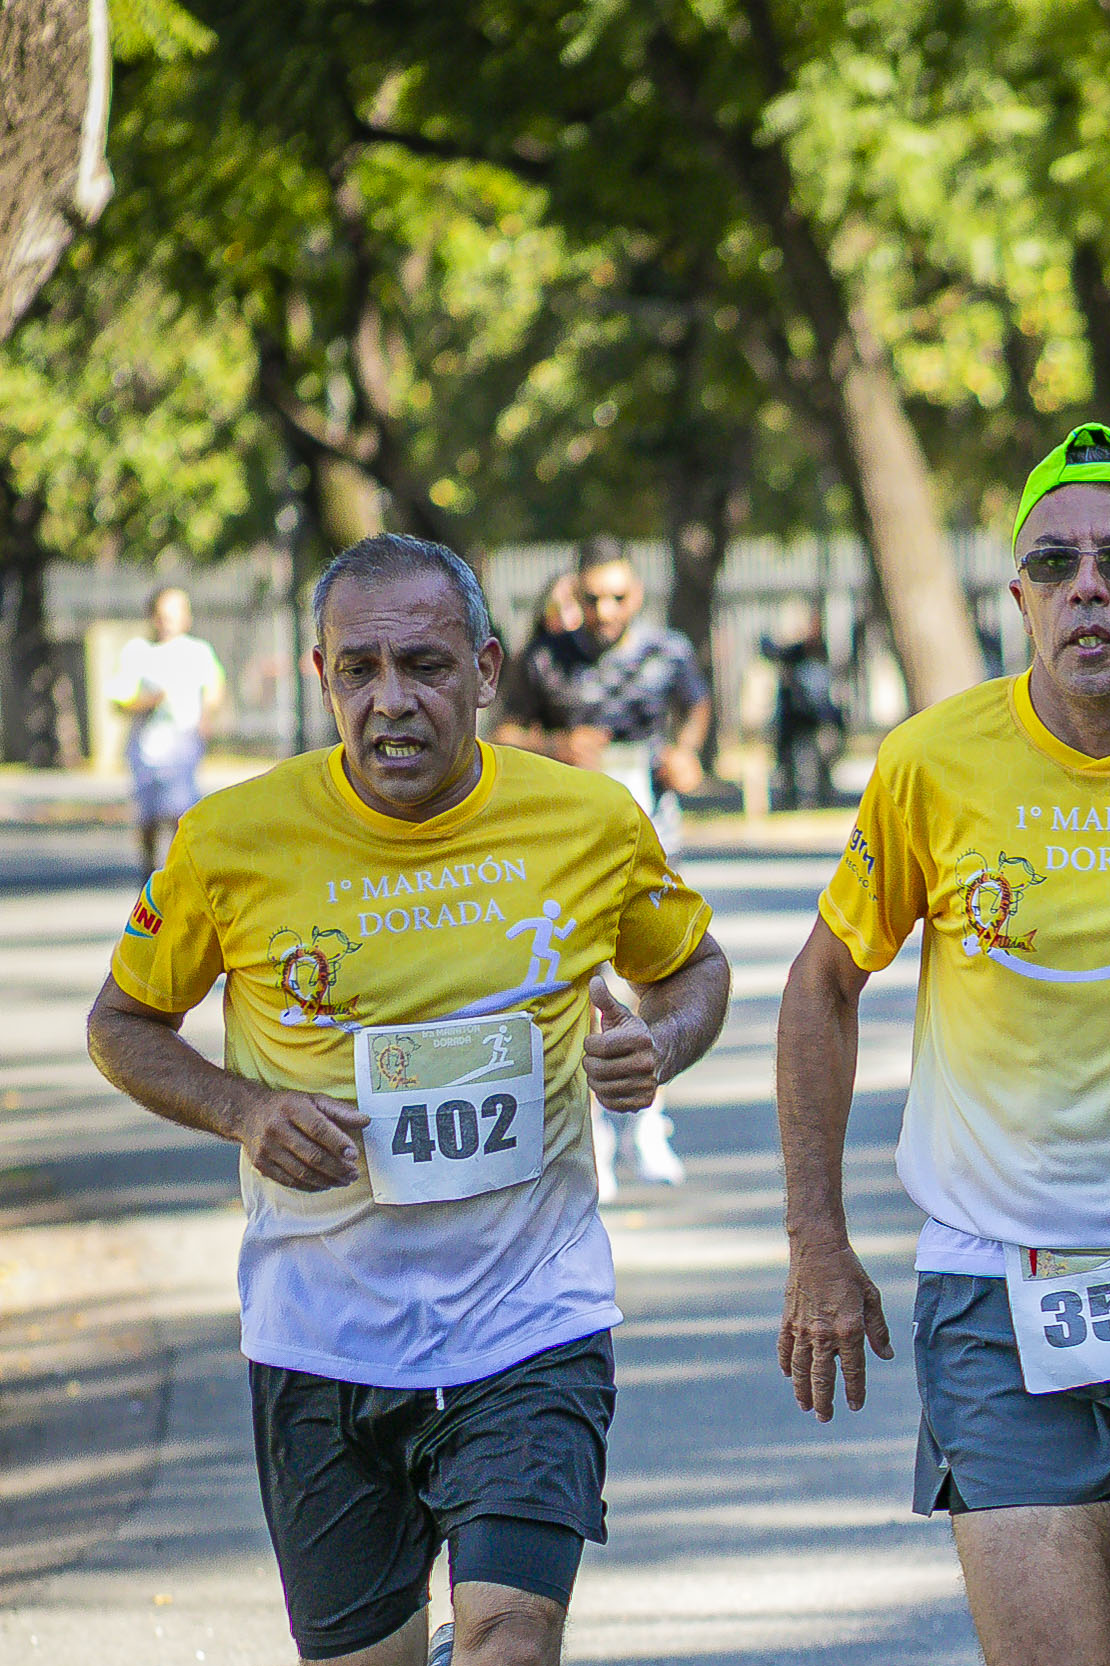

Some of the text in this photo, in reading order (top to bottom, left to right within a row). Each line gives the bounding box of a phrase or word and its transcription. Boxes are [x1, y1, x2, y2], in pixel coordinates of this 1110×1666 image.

[361, 855, 527, 901] MARATÓN
[357, 898, 506, 937] DORADA
[391, 1093, 518, 1163] 402
